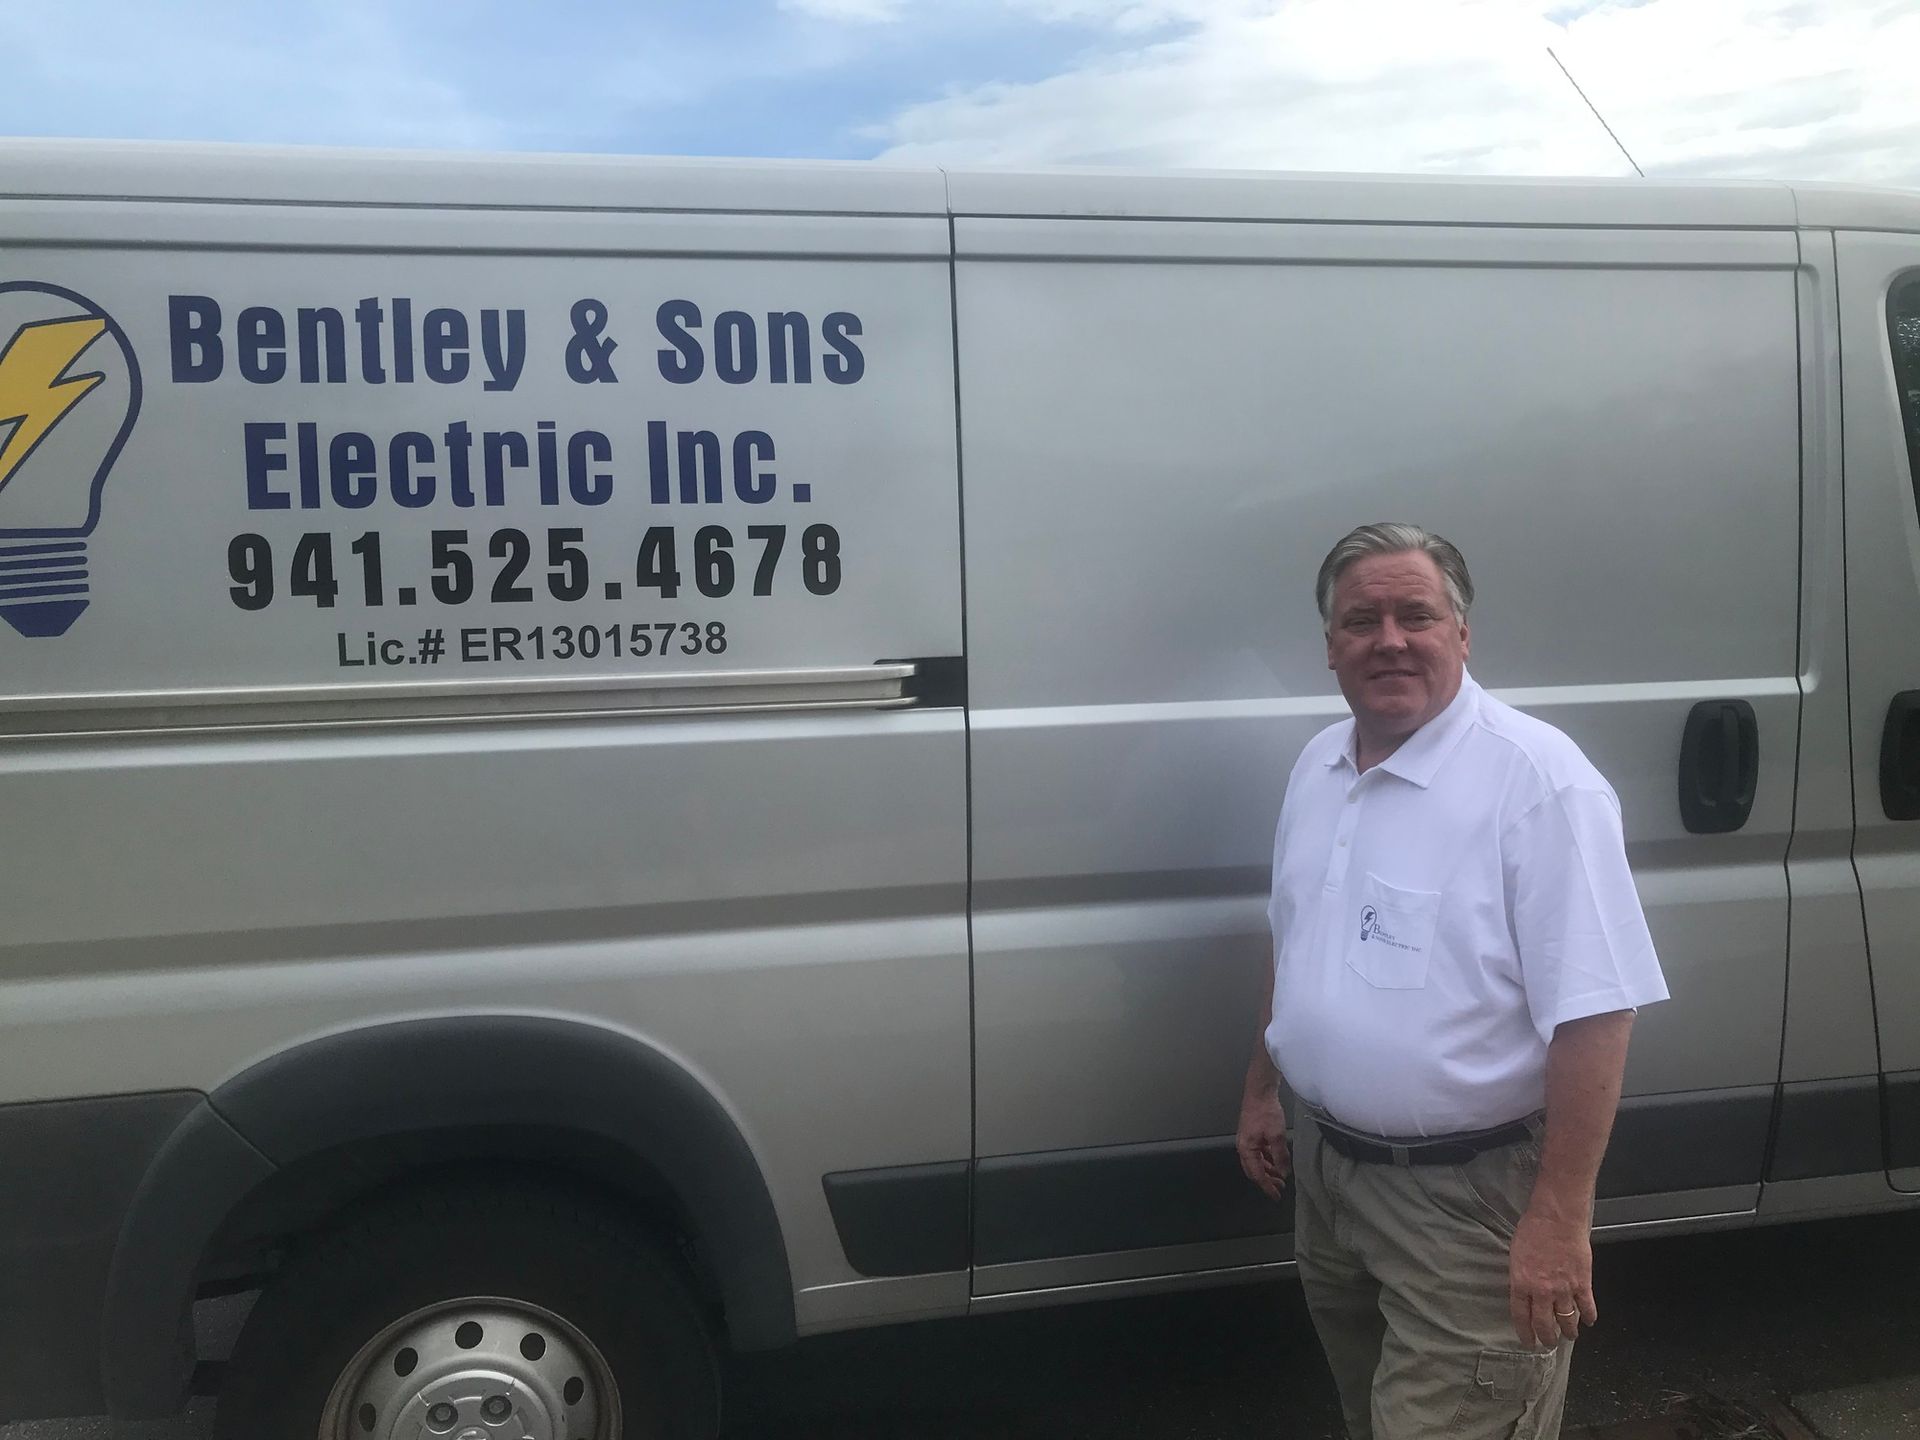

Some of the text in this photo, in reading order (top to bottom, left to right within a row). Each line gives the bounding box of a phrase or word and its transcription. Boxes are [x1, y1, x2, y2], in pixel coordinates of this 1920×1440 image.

[168, 294, 865, 392] Bentley & Sons
[243, 420, 812, 511] Electric Inc.
[227, 523, 842, 612] 941.525.4678
[336, 621, 728, 668] Lic.# ER13015738
